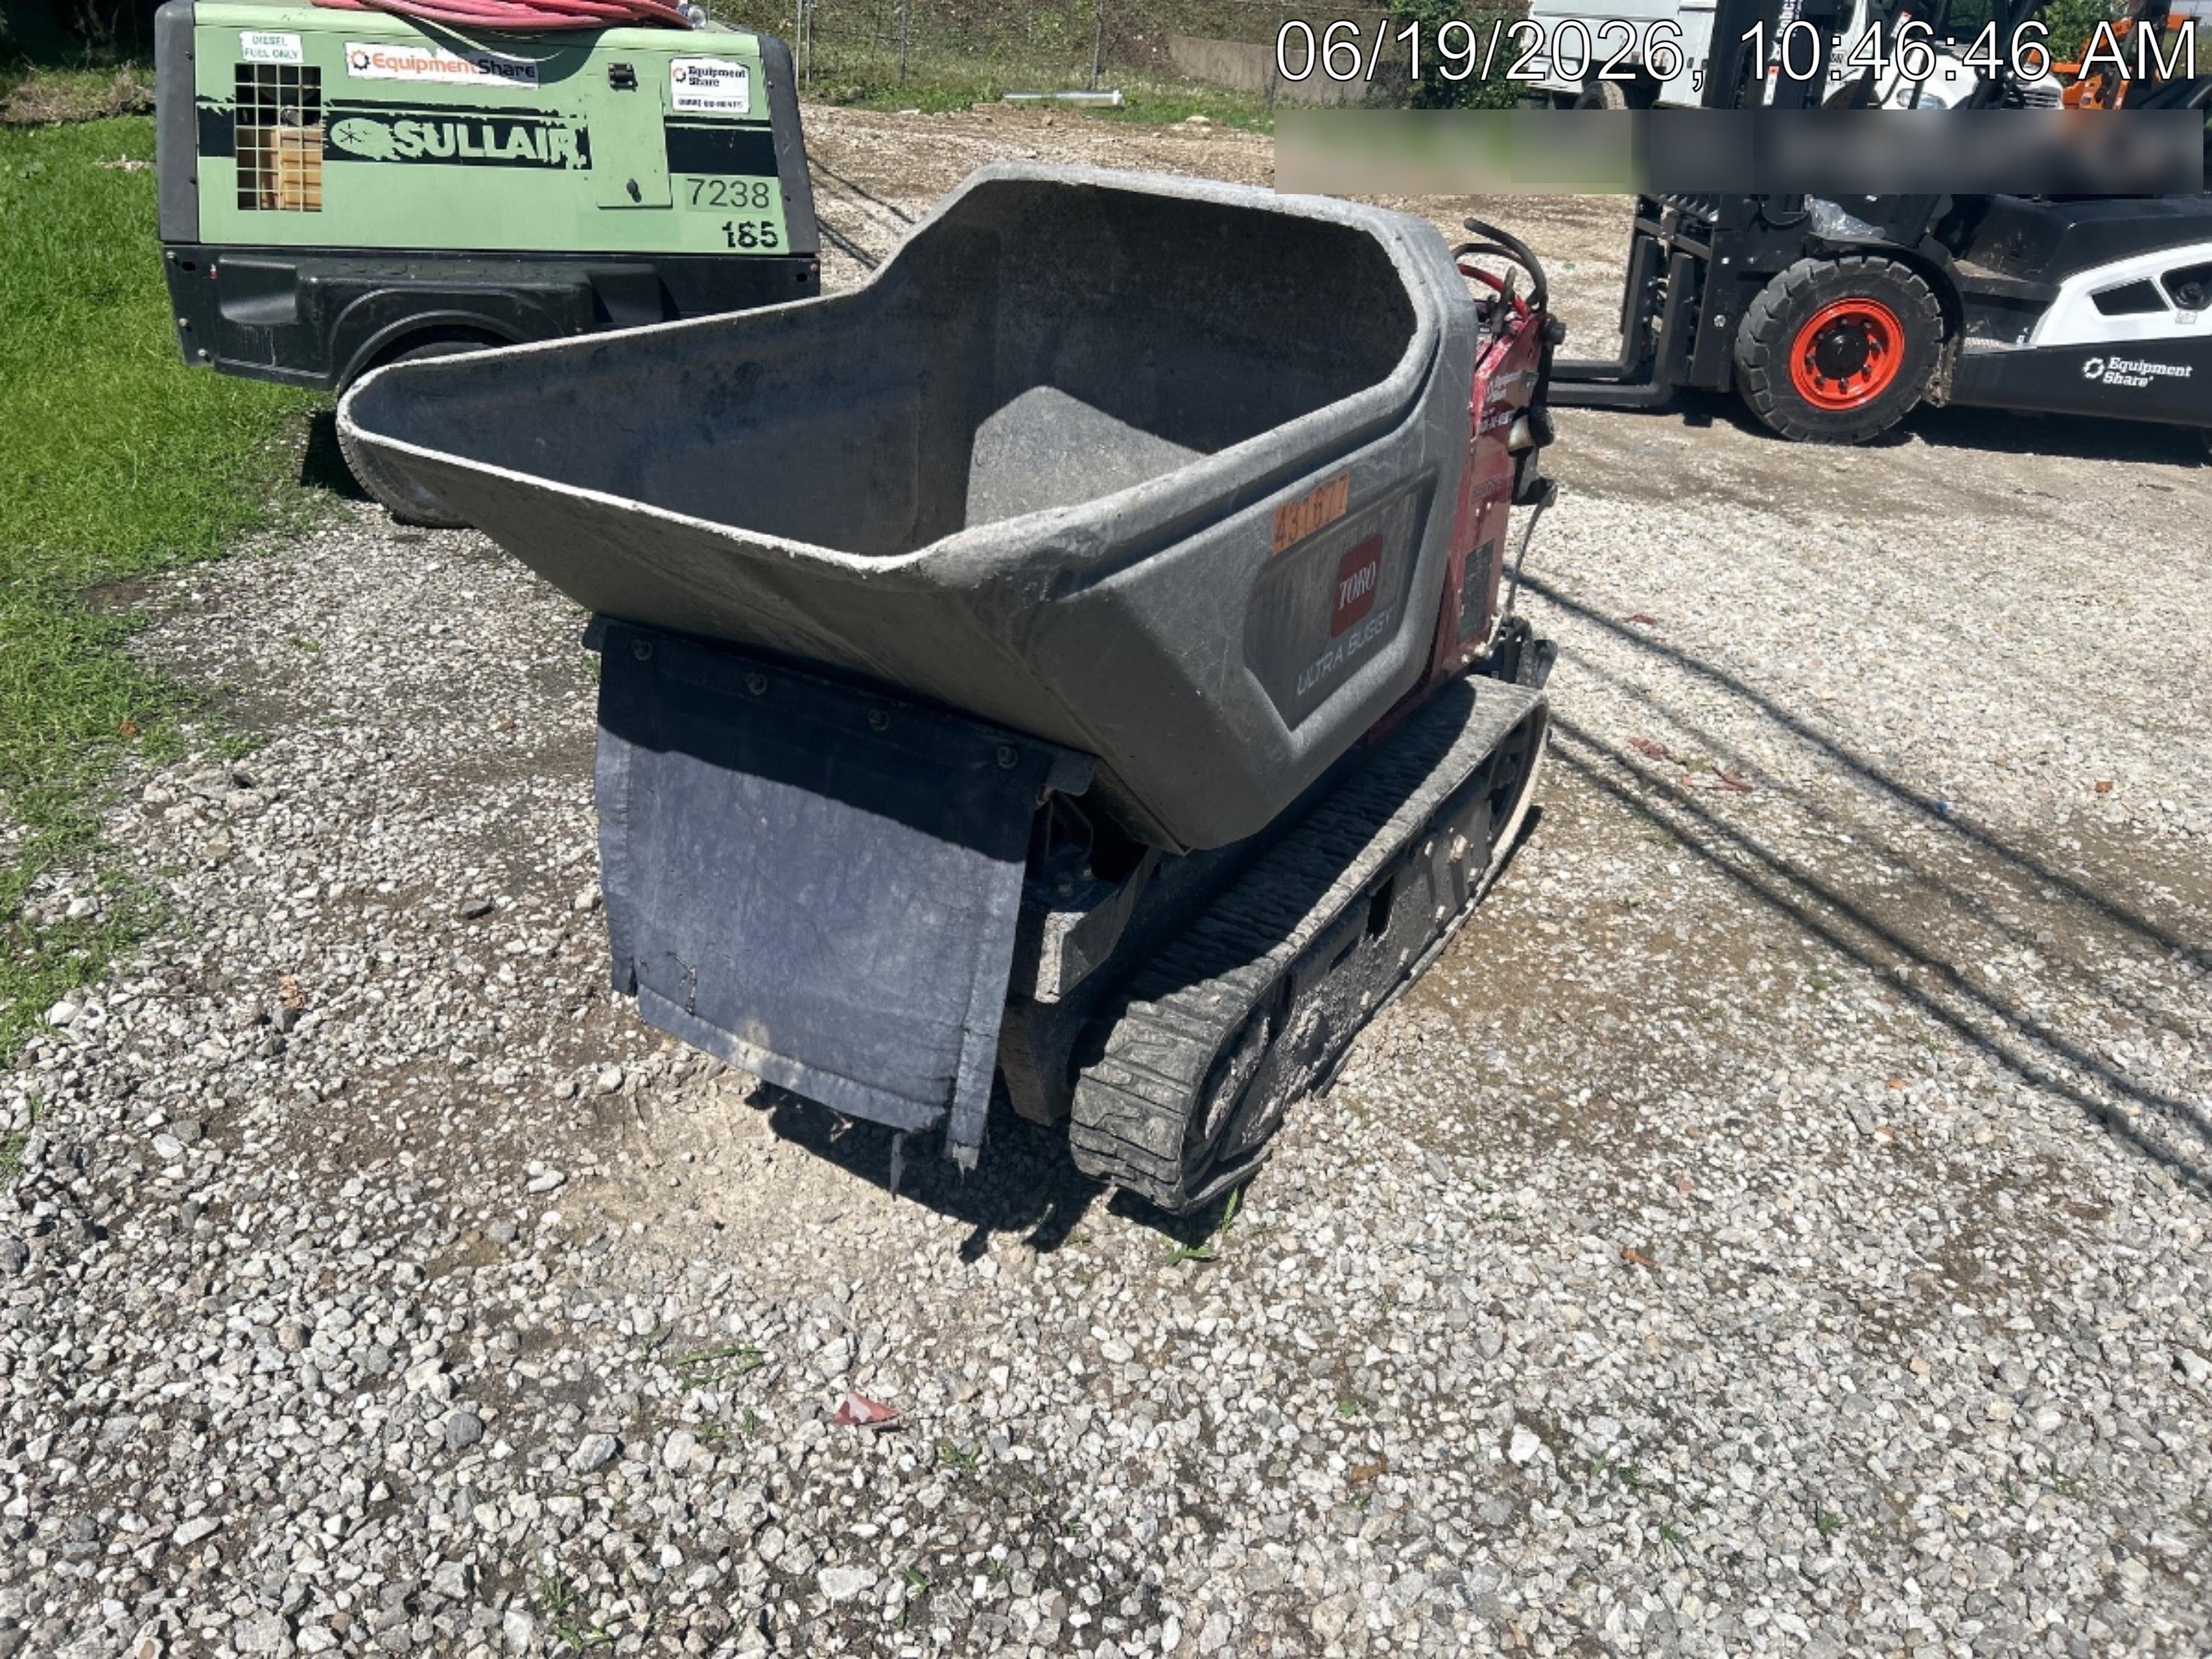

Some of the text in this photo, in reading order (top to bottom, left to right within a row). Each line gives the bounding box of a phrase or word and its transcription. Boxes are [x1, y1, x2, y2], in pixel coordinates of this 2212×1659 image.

[245, 48, 299, 59] FUEL ONLY
[252, 36, 288, 46] DIESEL
[372, 52, 536, 78] EquipmentShare
[688, 66, 745, 78] Equipment
[689, 76, 720, 87] Share
[393, 119, 584, 166] SULLAIR
[686, 178, 770, 209] 7238
[722, 221, 779, 248] 185
[2107, 356, 2194, 377] Equipment
[1338, 560, 1376, 611] TORO
[1297, 606, 1393, 696] ULTRA BUGGY
